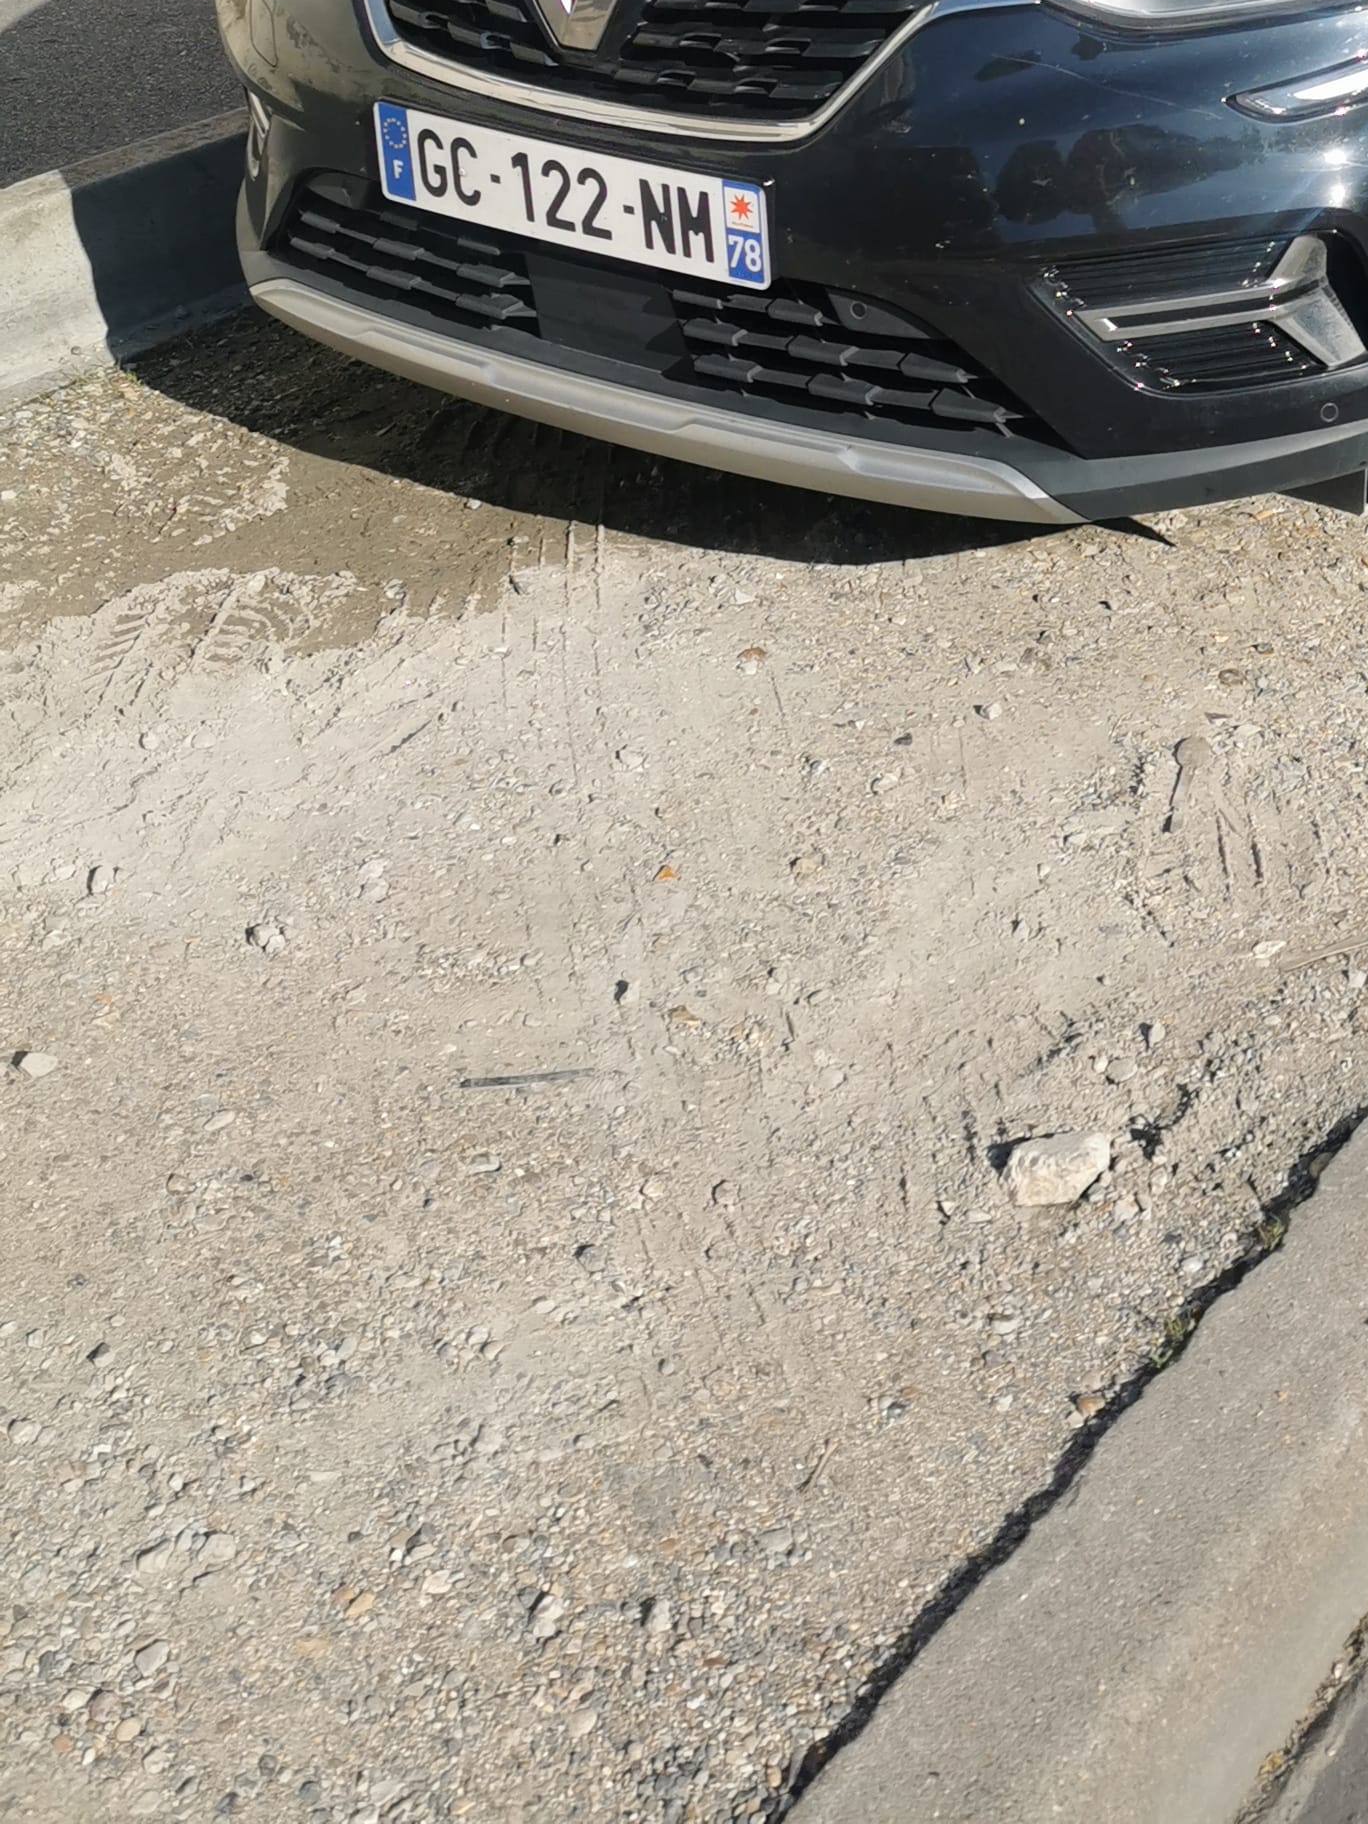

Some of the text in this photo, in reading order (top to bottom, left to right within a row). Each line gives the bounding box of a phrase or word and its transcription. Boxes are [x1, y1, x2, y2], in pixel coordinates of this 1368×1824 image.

[393, 160, 404, 179] F
[417, 129, 715, 263] GC-122-NM
[728, 235, 762, 273] 78
